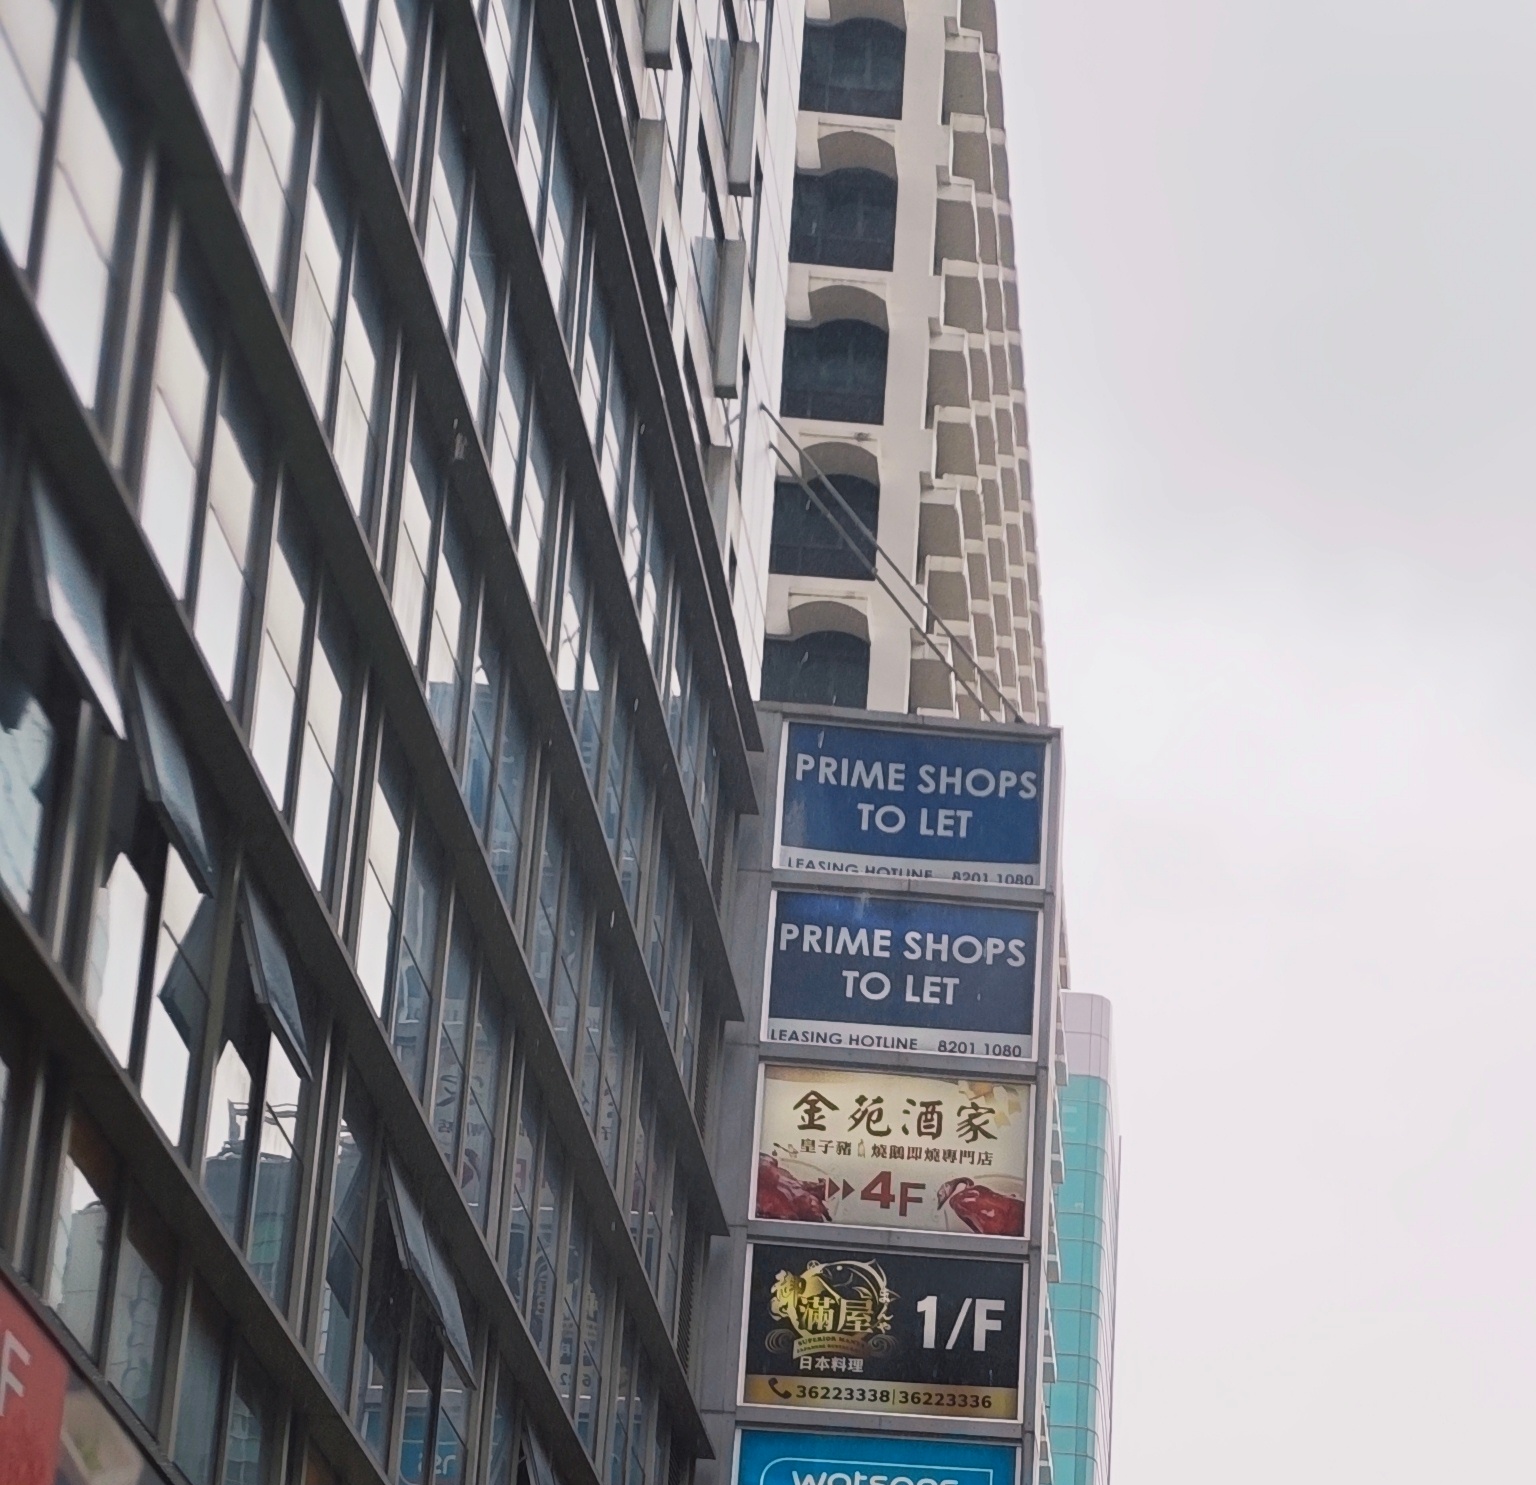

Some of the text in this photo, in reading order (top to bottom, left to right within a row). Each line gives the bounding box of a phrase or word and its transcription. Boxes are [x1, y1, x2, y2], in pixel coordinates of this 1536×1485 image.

[795, 753, 1038, 799] PRIME SHOPS
[857, 803, 973, 838] TO LET
[779, 922, 1026, 967] PRIME SHOPS
[842, 969, 960, 1005] TO LET
[770, 1028, 1022, 1058] LEASING HOTLINE 8201 1080
[793, 1089, 998, 1143] 金苑酒家
[860, 1170, 926, 1217] 4F
[917, 1295, 1006, 1351] 1/F
[799, 1356, 864, 1373] 日本料理
[796, 1385, 992, 1409] 36223338 36223336
